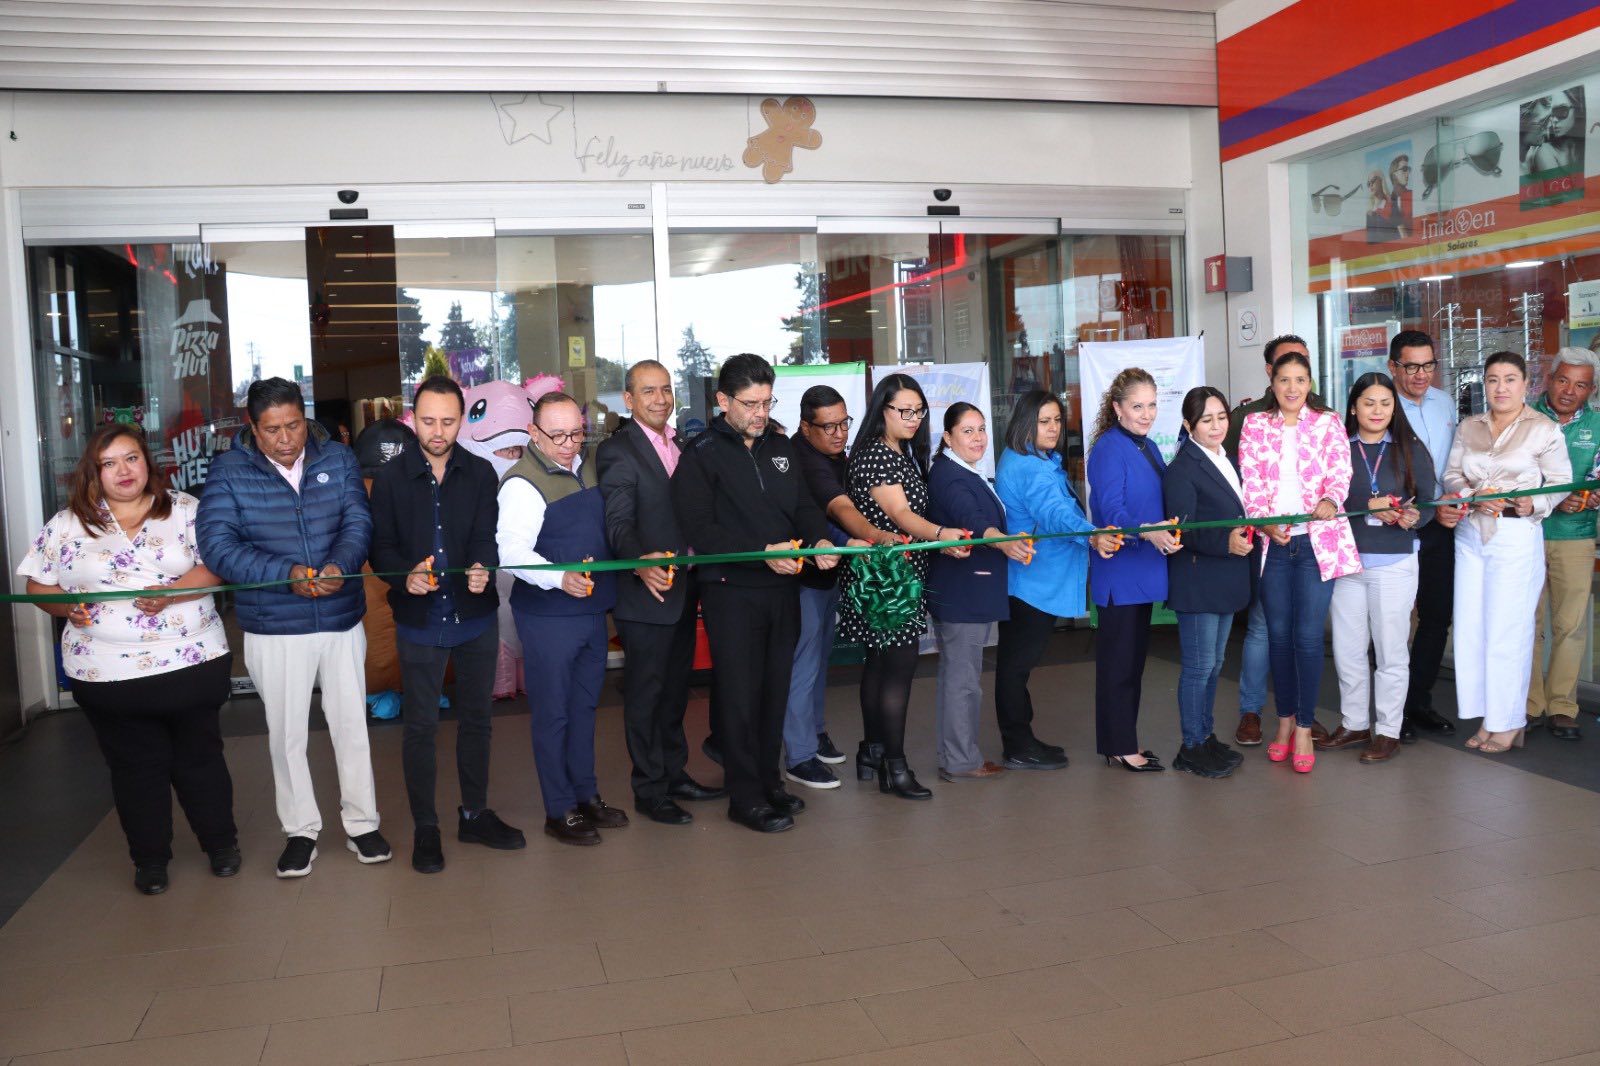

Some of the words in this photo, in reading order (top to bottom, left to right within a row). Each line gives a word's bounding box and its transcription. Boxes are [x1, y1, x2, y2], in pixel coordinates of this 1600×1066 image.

[638, 151, 677, 170] año
[681, 154, 735, 171] nuevo
[1421, 209, 1496, 240] Imagen
[1447, 239, 1479, 251] Solares
[170, 324, 219, 357] Pizza
[173, 350, 209, 380] Hut
[172, 426, 215, 467] HUT
[170, 458, 210, 490] WEE
